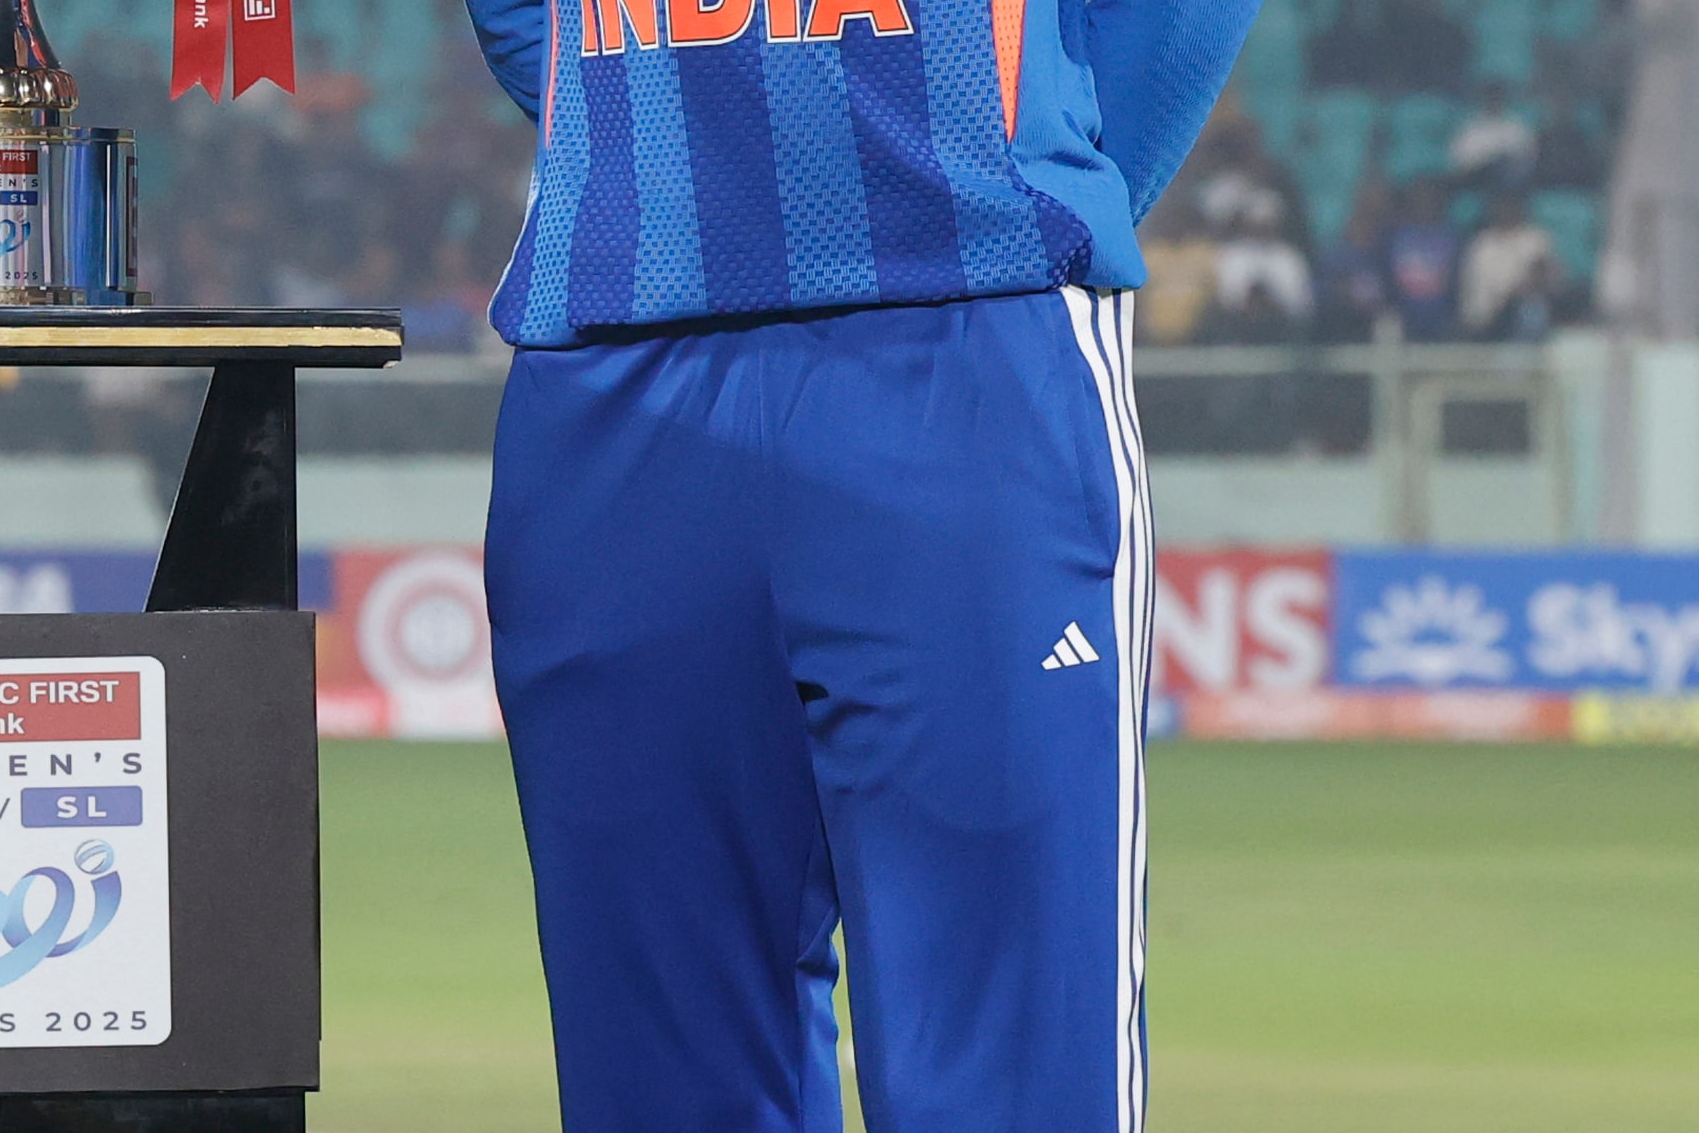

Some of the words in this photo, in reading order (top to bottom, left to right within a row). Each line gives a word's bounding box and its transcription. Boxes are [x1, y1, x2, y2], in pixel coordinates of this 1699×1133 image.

[2, 152, 31, 161] FIRST
[10, 194, 28, 203] SL
[5, 271, 39, 280] 2025
[29, 680, 120, 705] FIRST
[56, 795, 108, 819] SL
[45, 1010, 148, 1033] 2025
